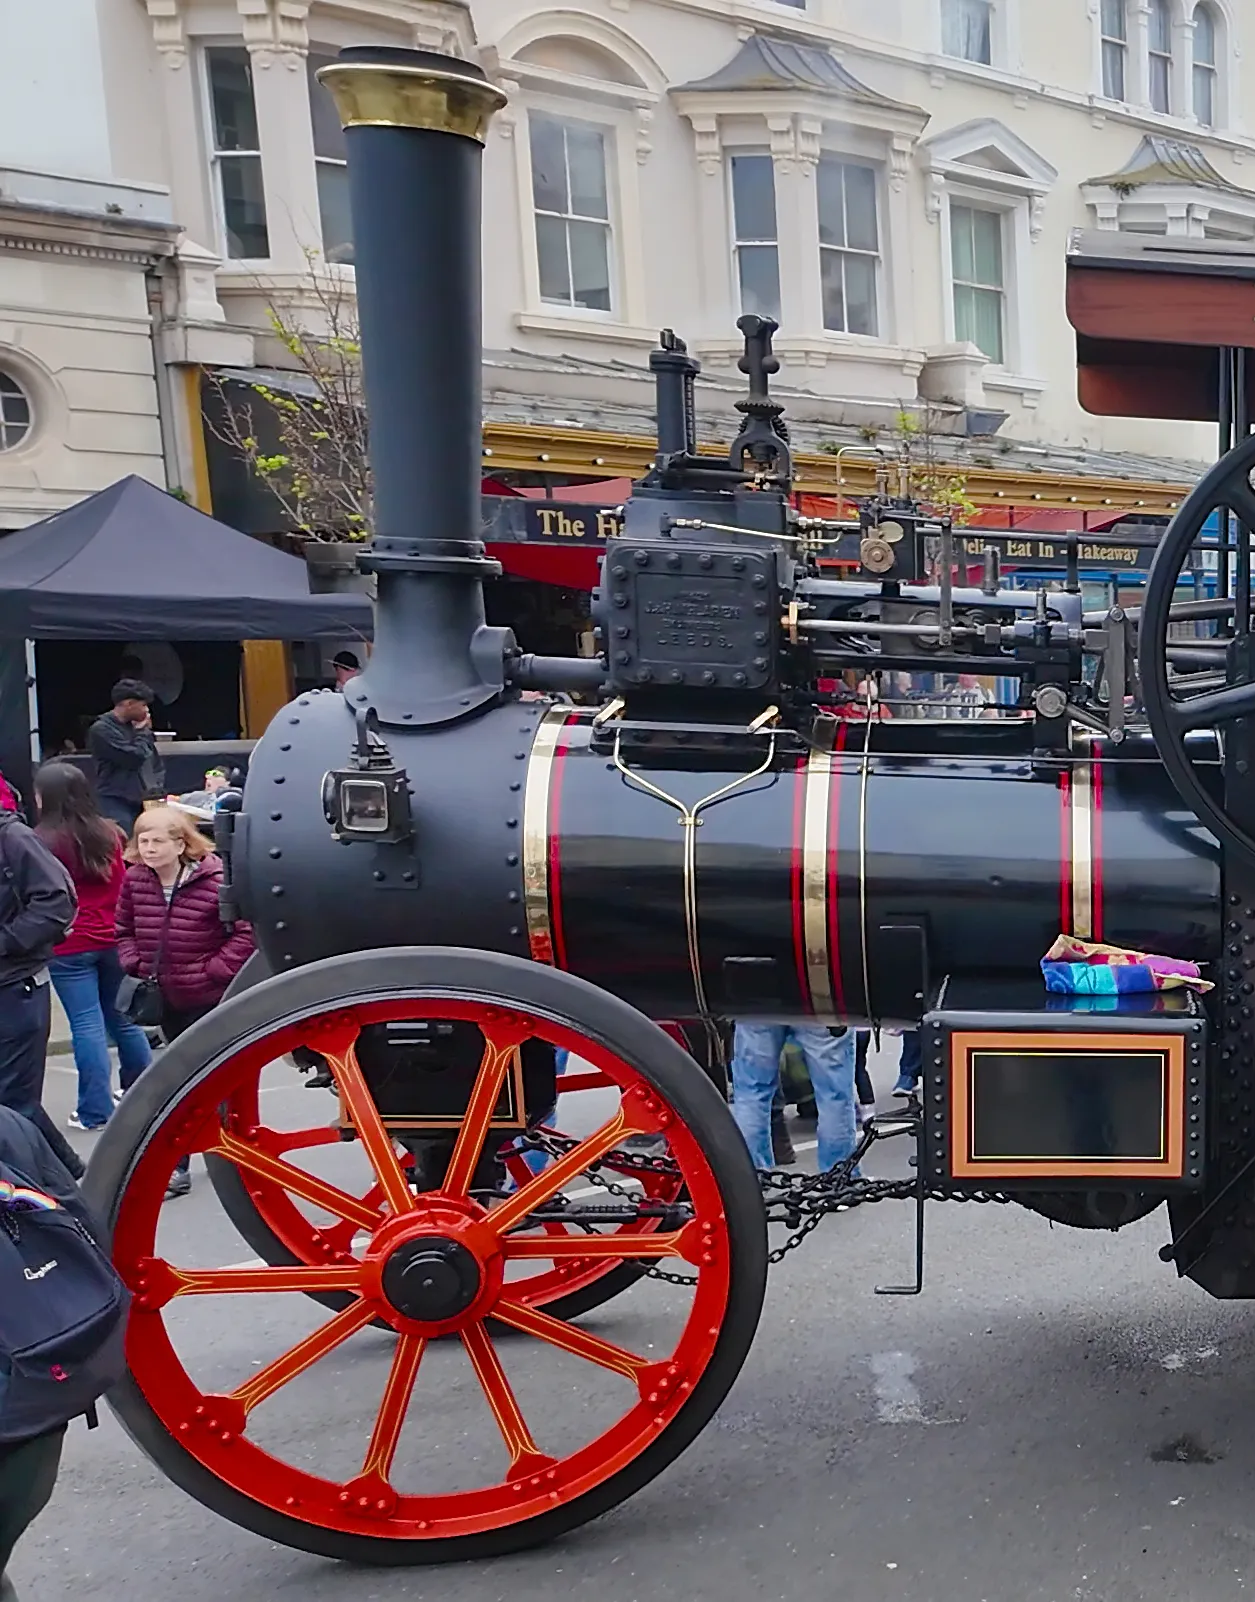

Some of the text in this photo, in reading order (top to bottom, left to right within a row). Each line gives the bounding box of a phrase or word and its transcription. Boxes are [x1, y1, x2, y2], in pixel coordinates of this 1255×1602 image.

[536, 509, 586, 537] The
[1006, 540, 1032, 557] Eat
[1038, 542, 1055, 559] In
